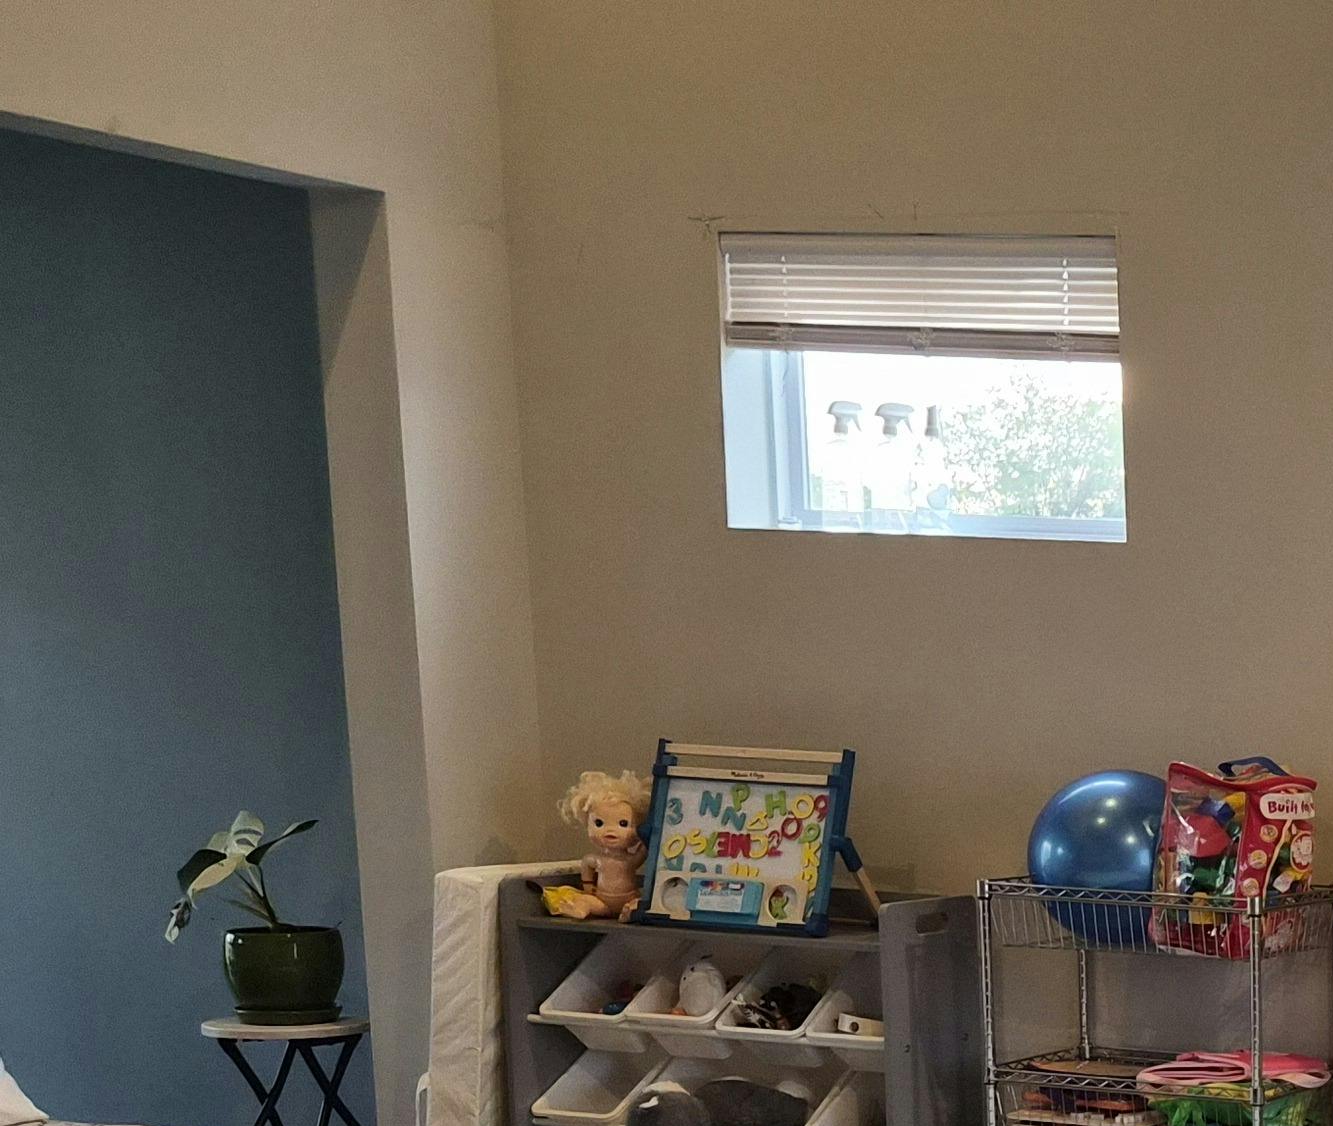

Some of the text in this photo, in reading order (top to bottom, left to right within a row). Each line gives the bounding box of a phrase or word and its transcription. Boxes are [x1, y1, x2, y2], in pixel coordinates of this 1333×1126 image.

[699, 790, 723, 818] N
[764, 790, 787, 819] H
[1268, 799, 1298, 815] Built
[720, 806, 747, 832] N
